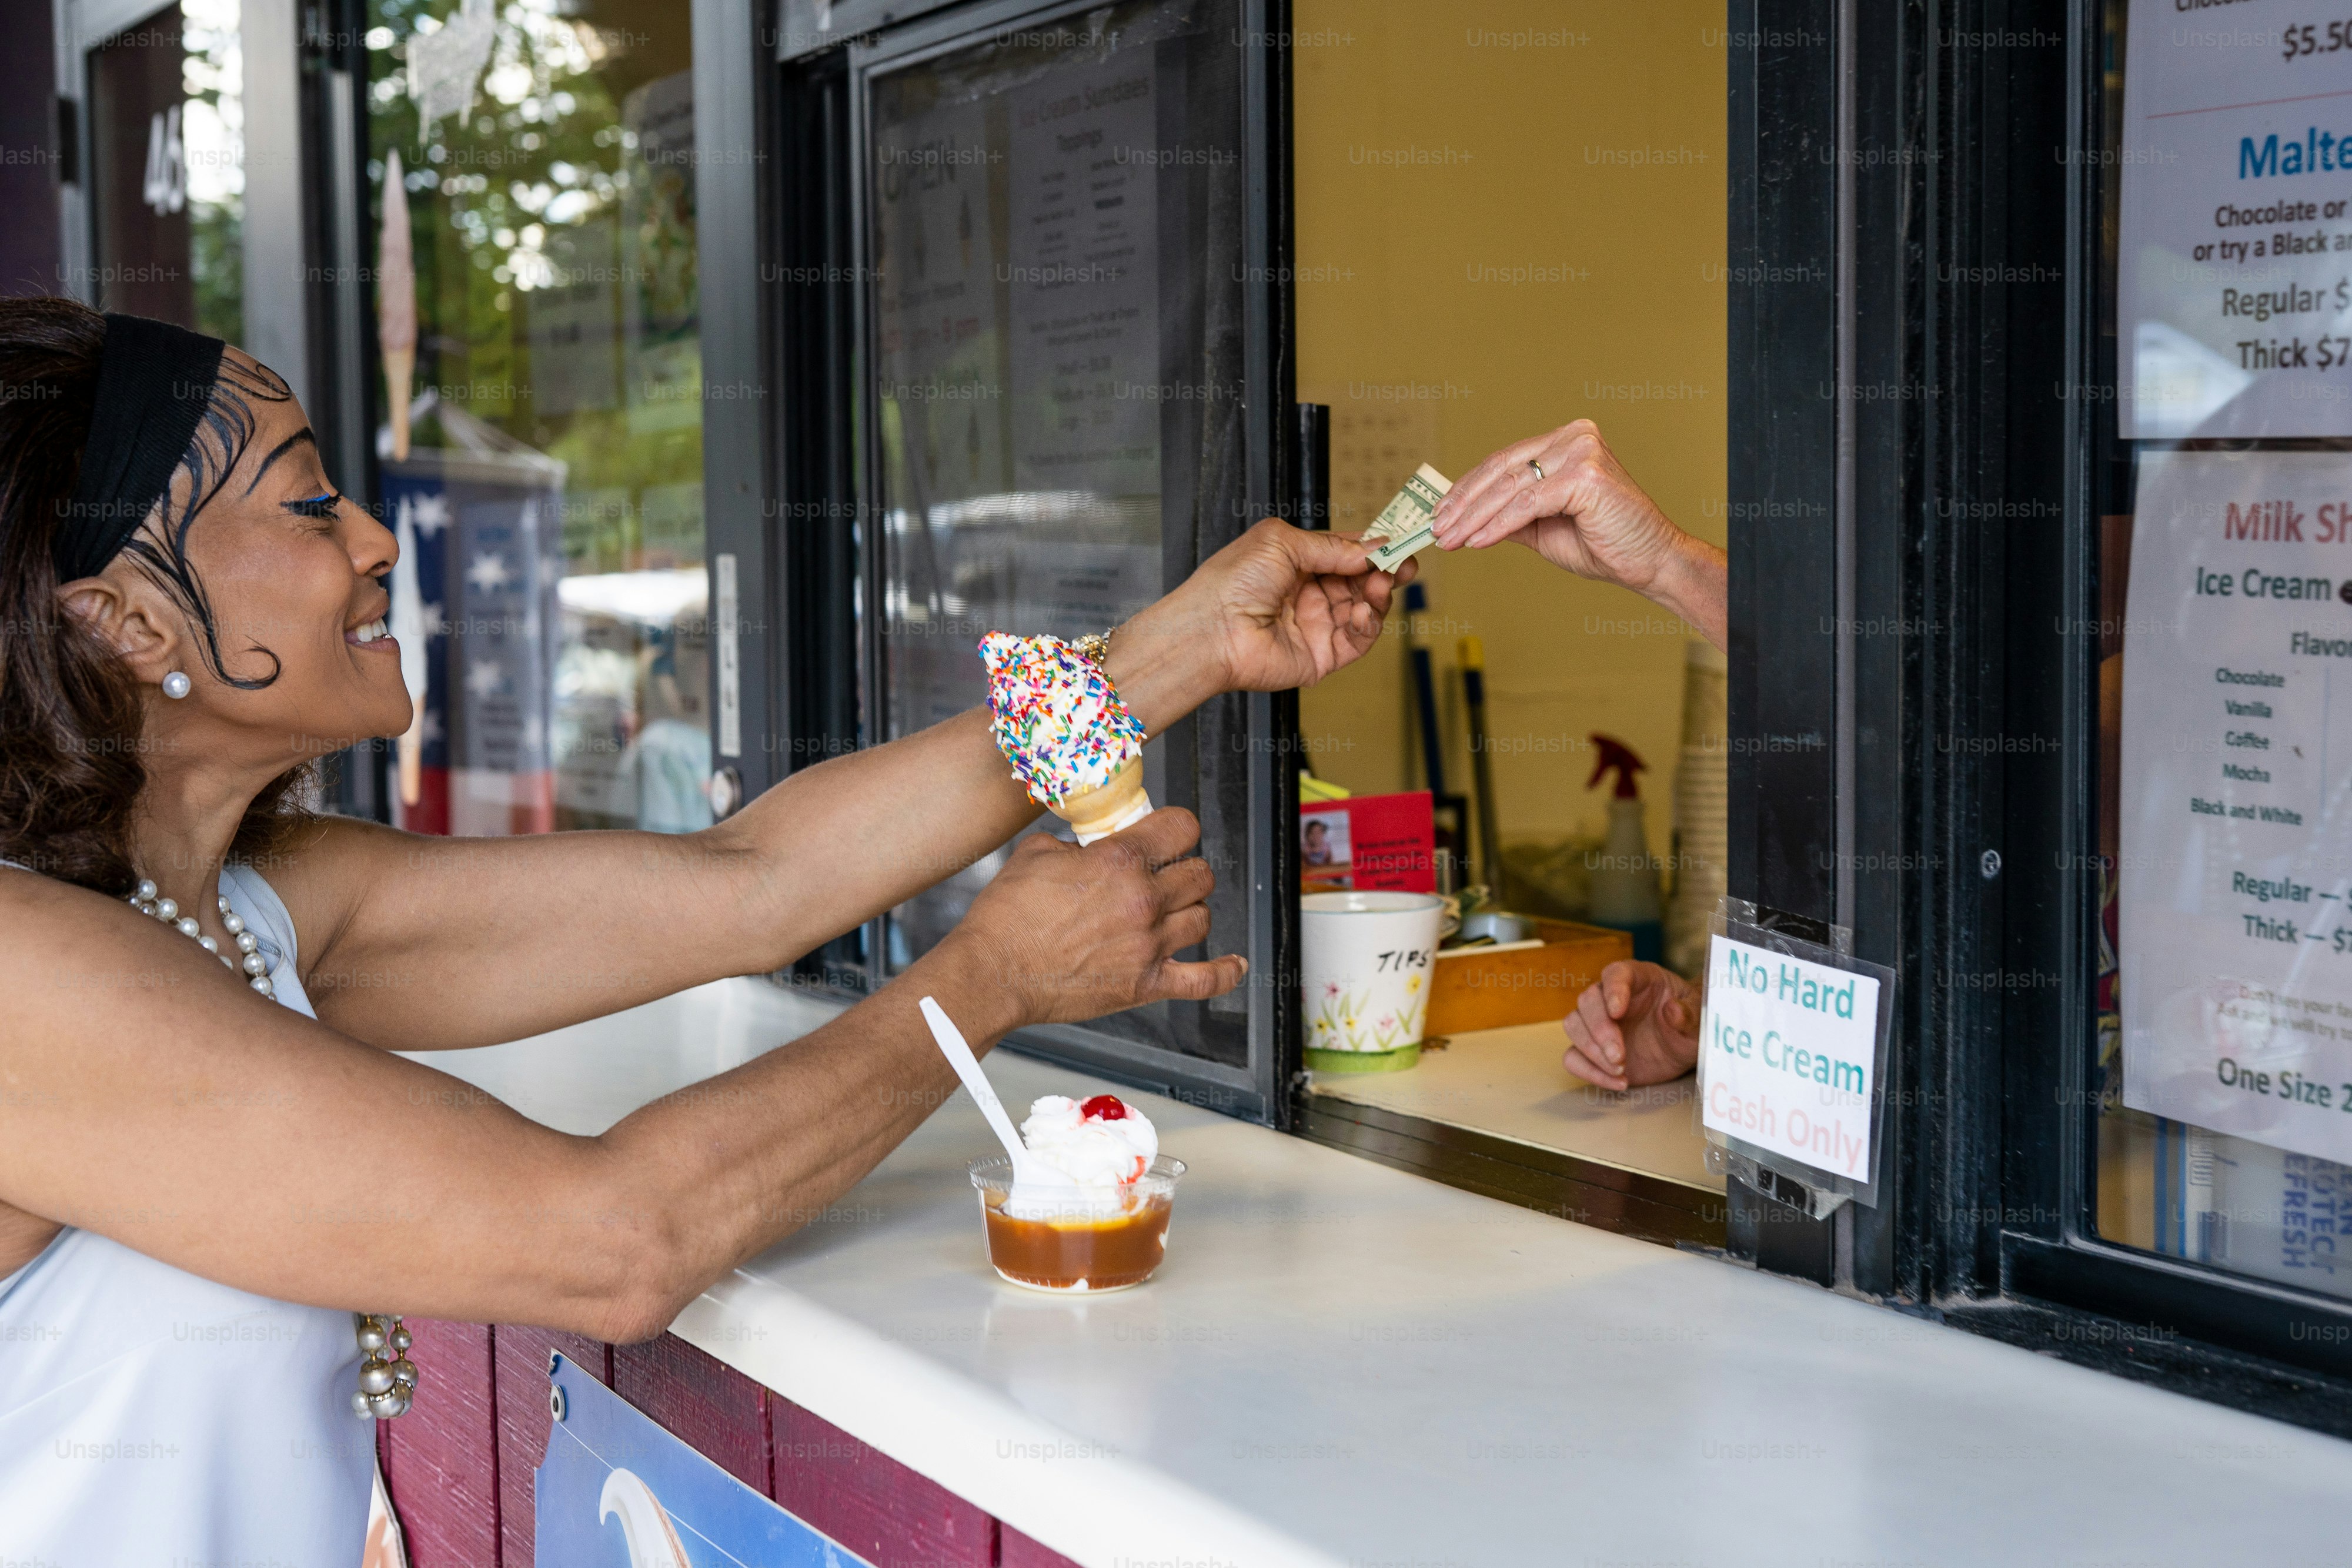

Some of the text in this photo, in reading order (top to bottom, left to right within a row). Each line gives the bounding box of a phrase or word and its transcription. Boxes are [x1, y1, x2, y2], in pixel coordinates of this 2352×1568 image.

[2215, 199, 2347, 228] Chocolate or
[2193, 243, 2215, 261] or
[2220, 239, 2249, 263] try
[2254, 240, 2266, 257] a
[2272, 230, 2327, 256] Black
[2222, 283, 2326, 322] Regular
[2237, 333, 2351, 372] Thick $7
[2224, 500, 2304, 542] Milk
[2197, 566, 2331, 601] Ice Cream
[2215, 667, 2285, 688] Chocolate
[2224, 700, 2273, 718] Vanilla
[2225, 731, 2270, 750] Coffee
[2223, 764, 2270, 783] Mocha
[2191, 797, 2303, 825] Black and White
[2232, 871, 2312, 902] Regular
[2242, 914, 2298, 943] Thick
[1377, 950, 1430, 973] TIPS
[1728, 948, 1855, 1021] No Hard
[1714, 1013, 1865, 1095] Ice Cream
[2217, 1057, 2270, 1095] One
[2278, 1070, 2332, 1108] Size
[1709, 1082, 1863, 1174] Cash Only
